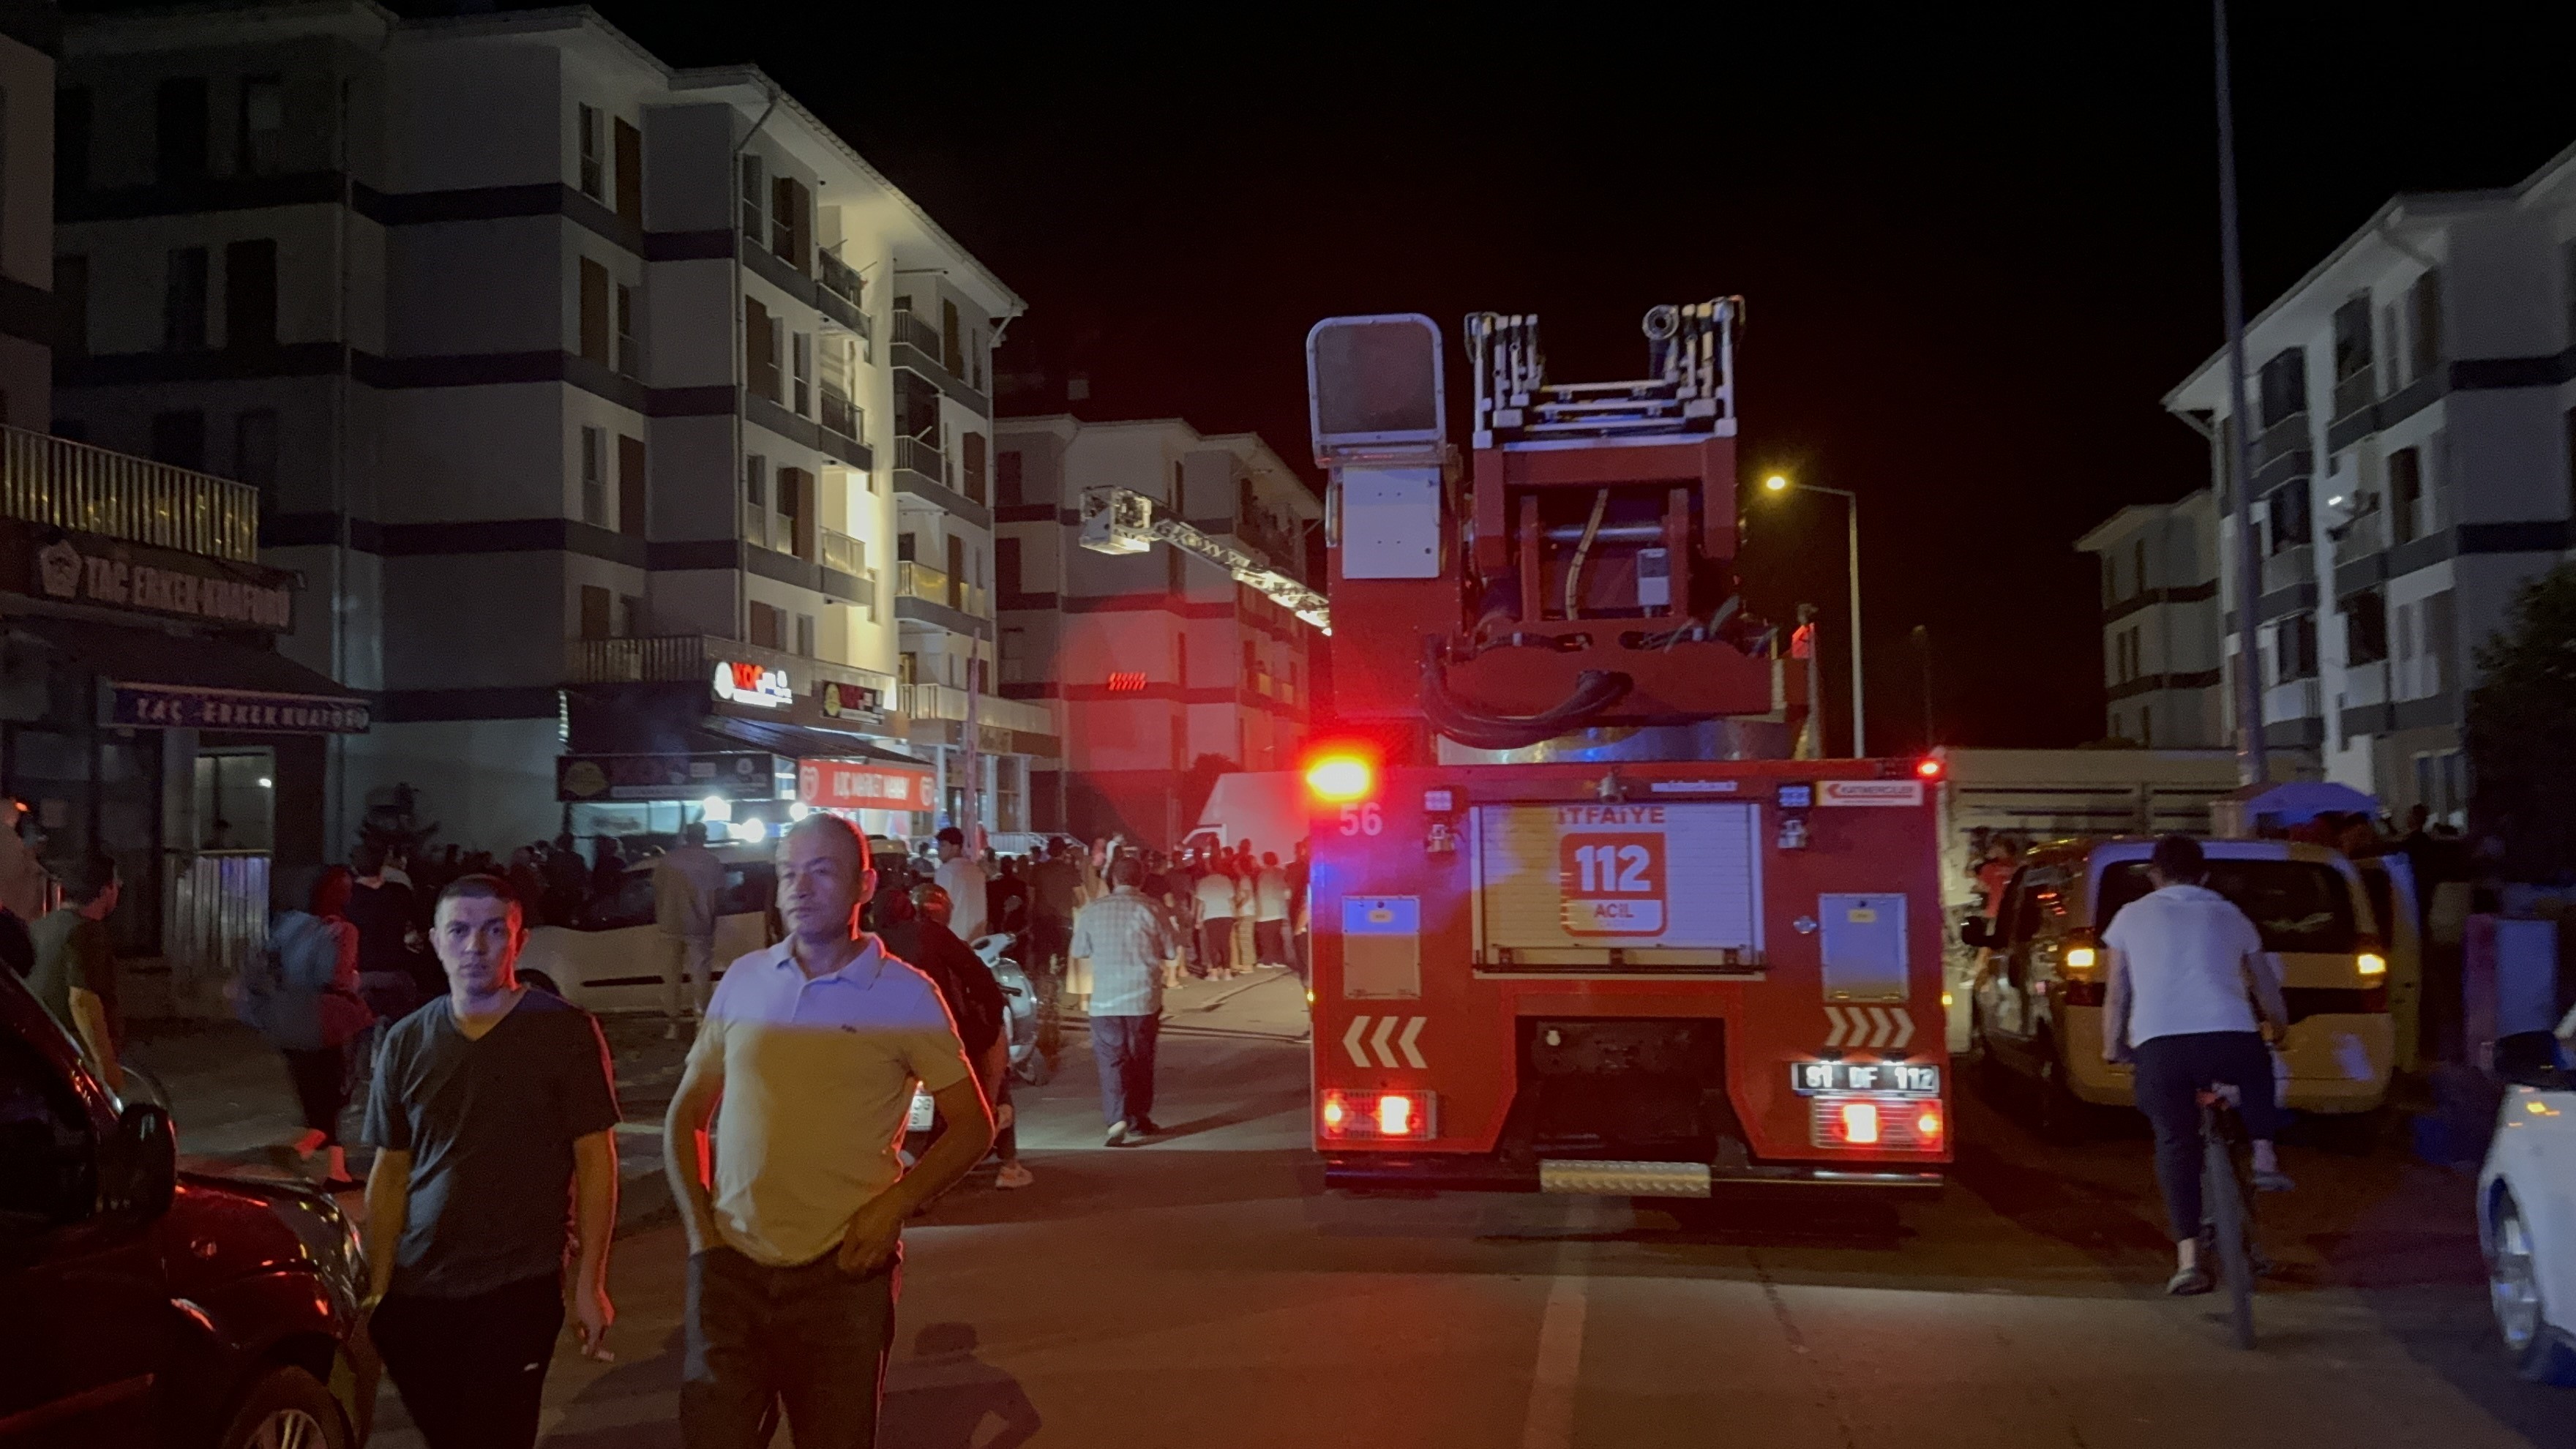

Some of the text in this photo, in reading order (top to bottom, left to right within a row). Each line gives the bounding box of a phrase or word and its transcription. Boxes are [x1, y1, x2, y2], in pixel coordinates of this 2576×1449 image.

[203, 700, 277, 724] ERKEK
[1340, 802, 1382, 836] 56
[1575, 845, 1652, 891] 112
[1805, 1066, 1832, 1088] 81
[1895, 1066, 1935, 1089] 112
